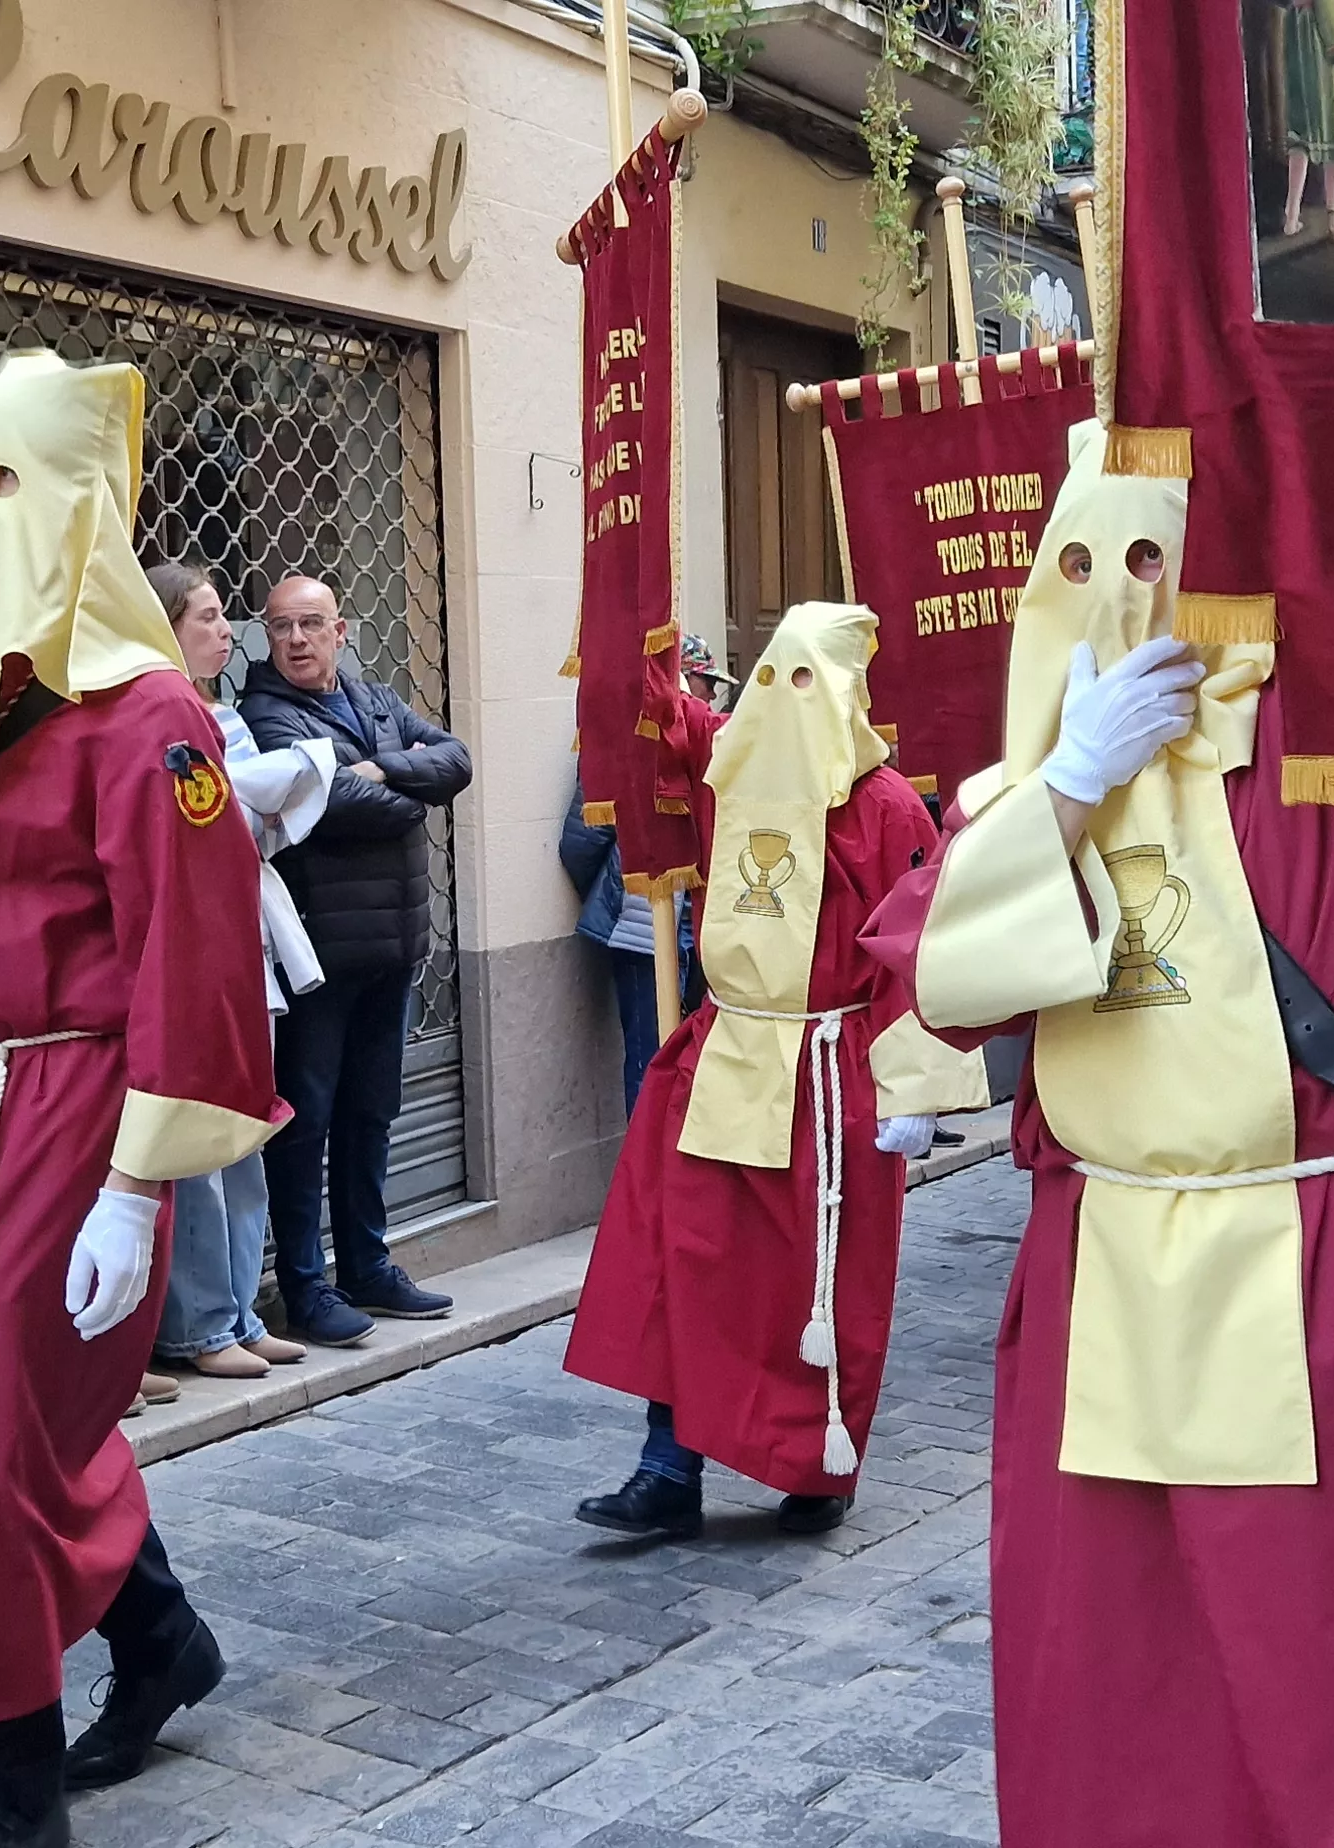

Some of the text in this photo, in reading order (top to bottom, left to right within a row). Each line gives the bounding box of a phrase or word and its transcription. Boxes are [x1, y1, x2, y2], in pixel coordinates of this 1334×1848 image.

[977, 476, 989, 512] Y
[991, 472, 1043, 513] COMED
[937, 519, 1033, 576] TODOS DE ÉL
[915, 595, 955, 636] ESTE
[957, 591, 978, 629] ES
[978, 587, 998, 626] MI
